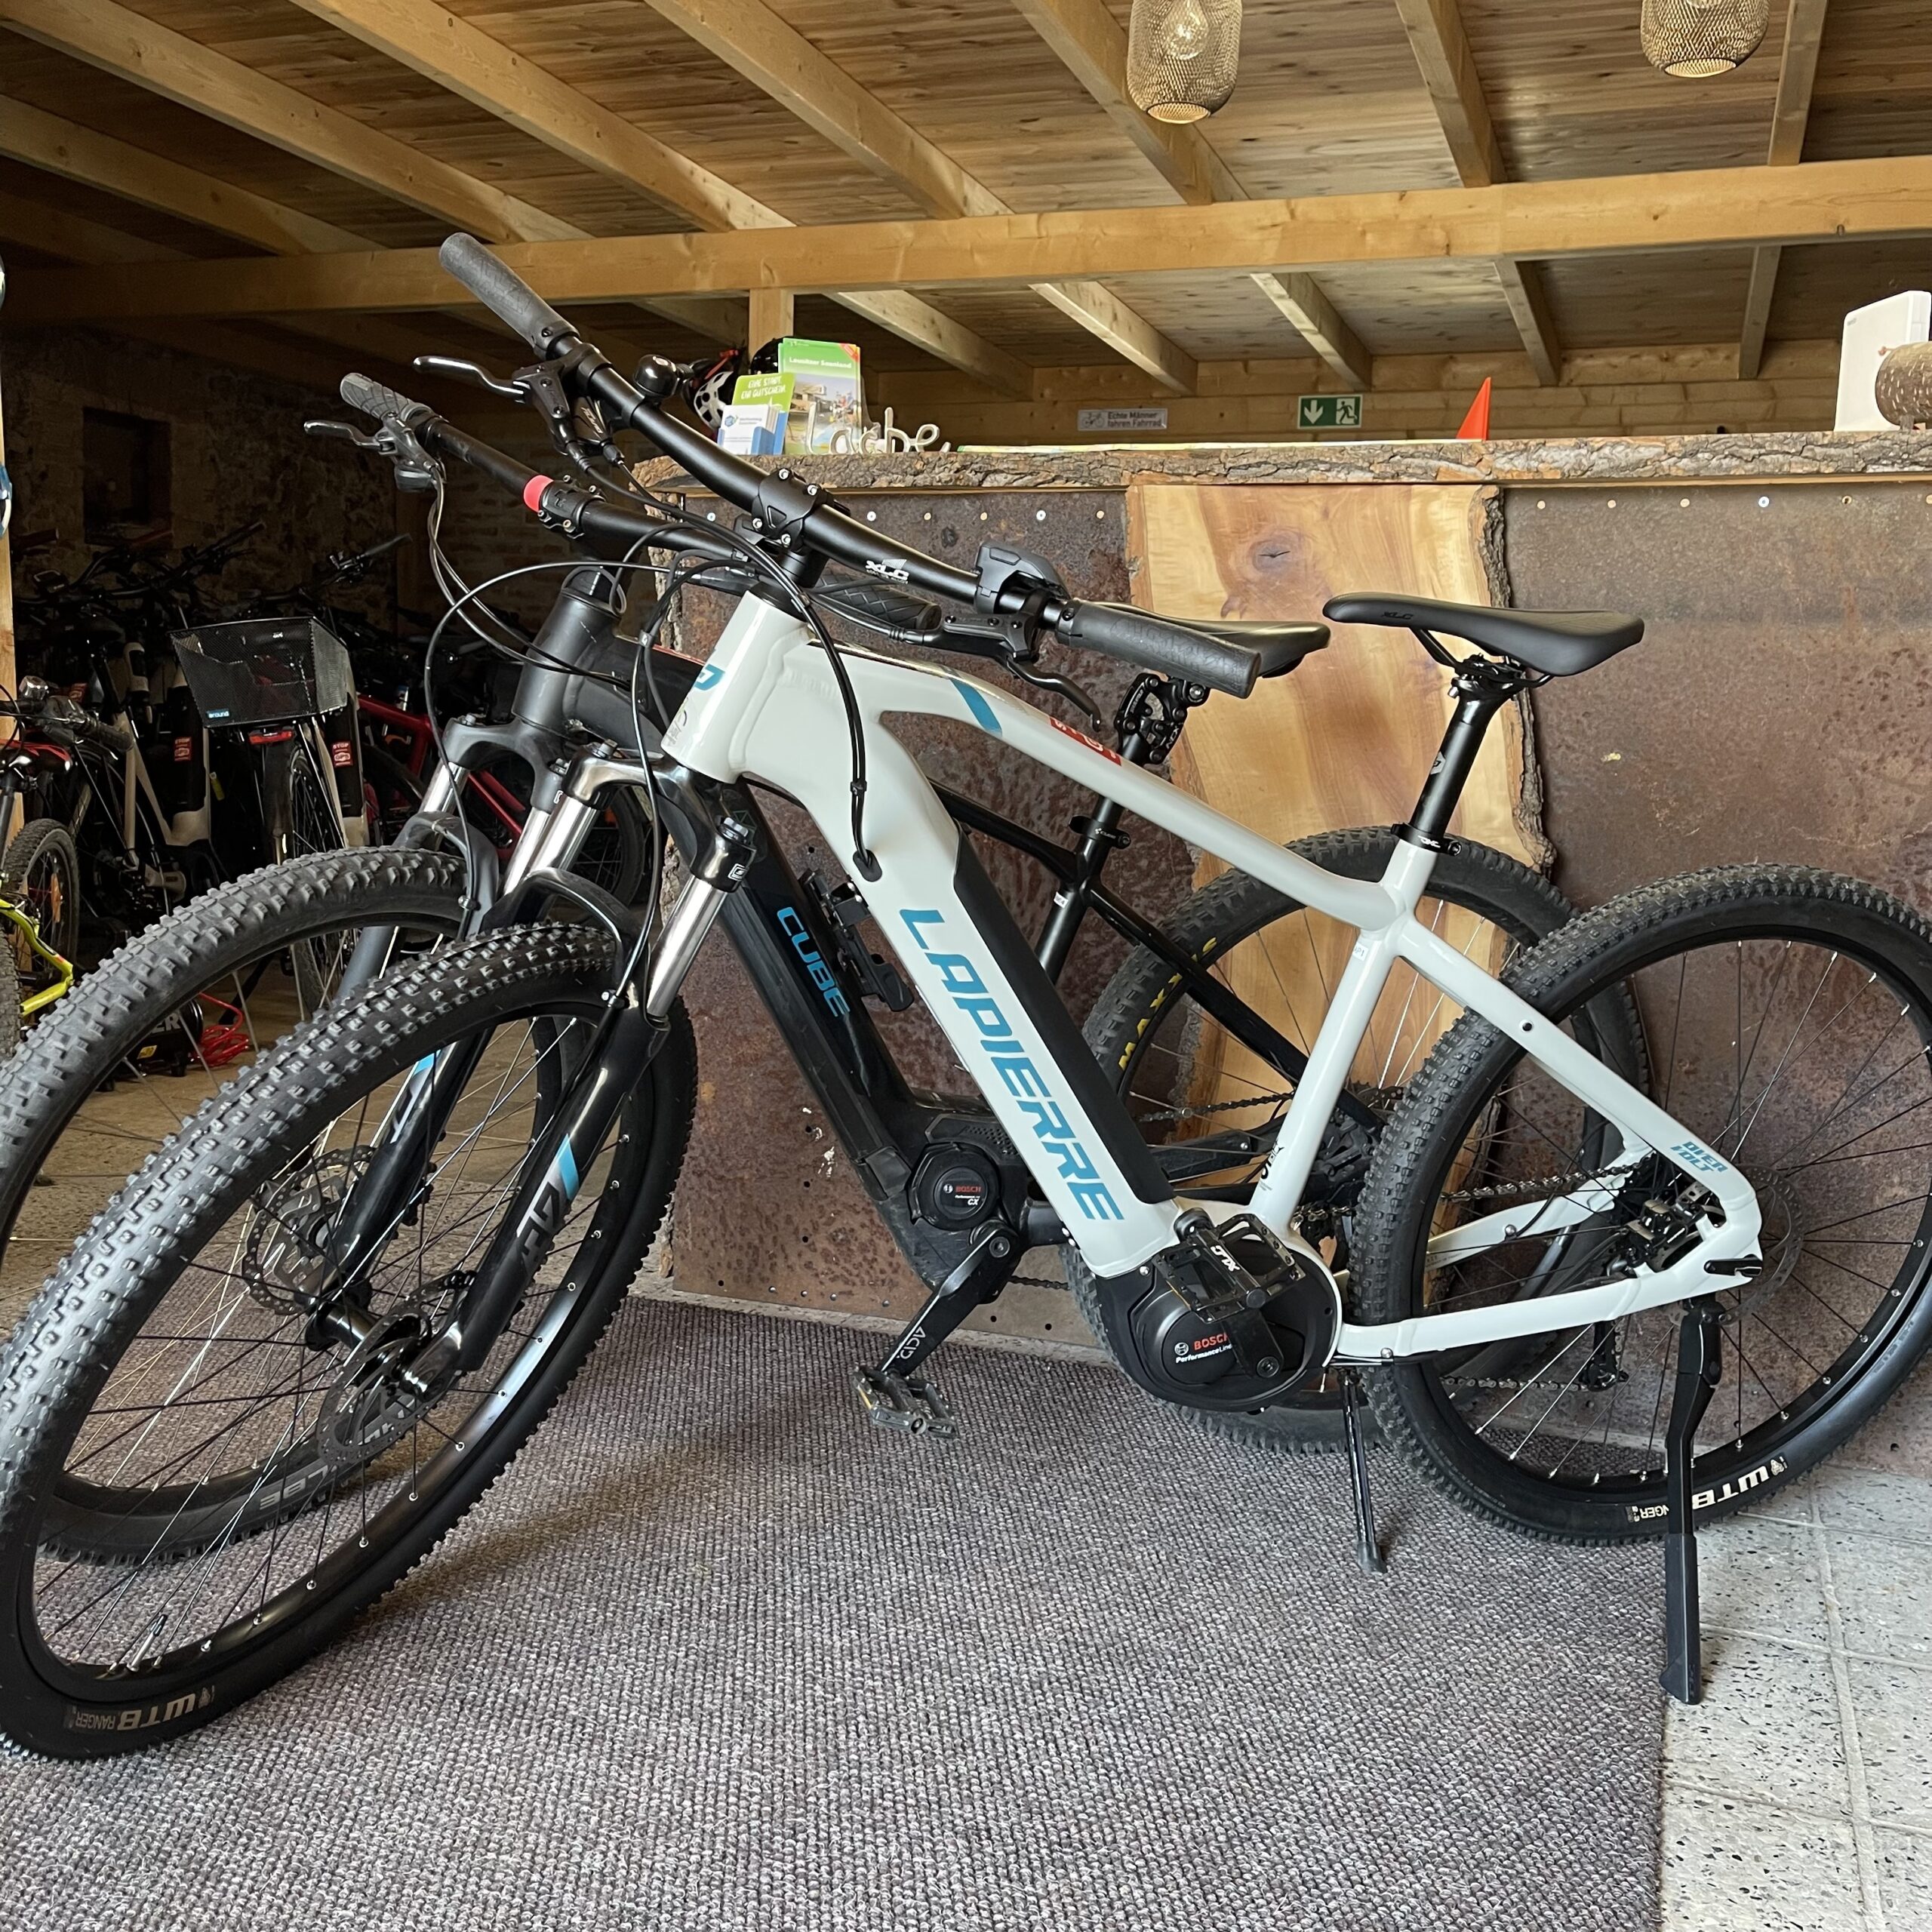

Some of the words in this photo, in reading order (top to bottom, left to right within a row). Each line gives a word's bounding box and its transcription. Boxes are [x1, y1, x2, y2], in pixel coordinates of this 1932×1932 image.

[1107, 420, 1131, 428] fahren
[1132, 419, 1162, 427] Fahrrad
[1108, 411, 1128, 420] Echte
[865, 560, 909, 581] XLC
[777, 906, 851, 1017] CUBE
[900, 909, 1124, 1221] LAPIERRE
[1670, 1146, 1714, 1171] VOLT
[1682, 1141, 1728, 1172] OVER
[1210, 1245, 1240, 1272] XLC
[1692, 1466, 1770, 1509] WTB
[76, 1712, 115, 1730] RANGER
[117, 1693, 195, 1730] WTB
